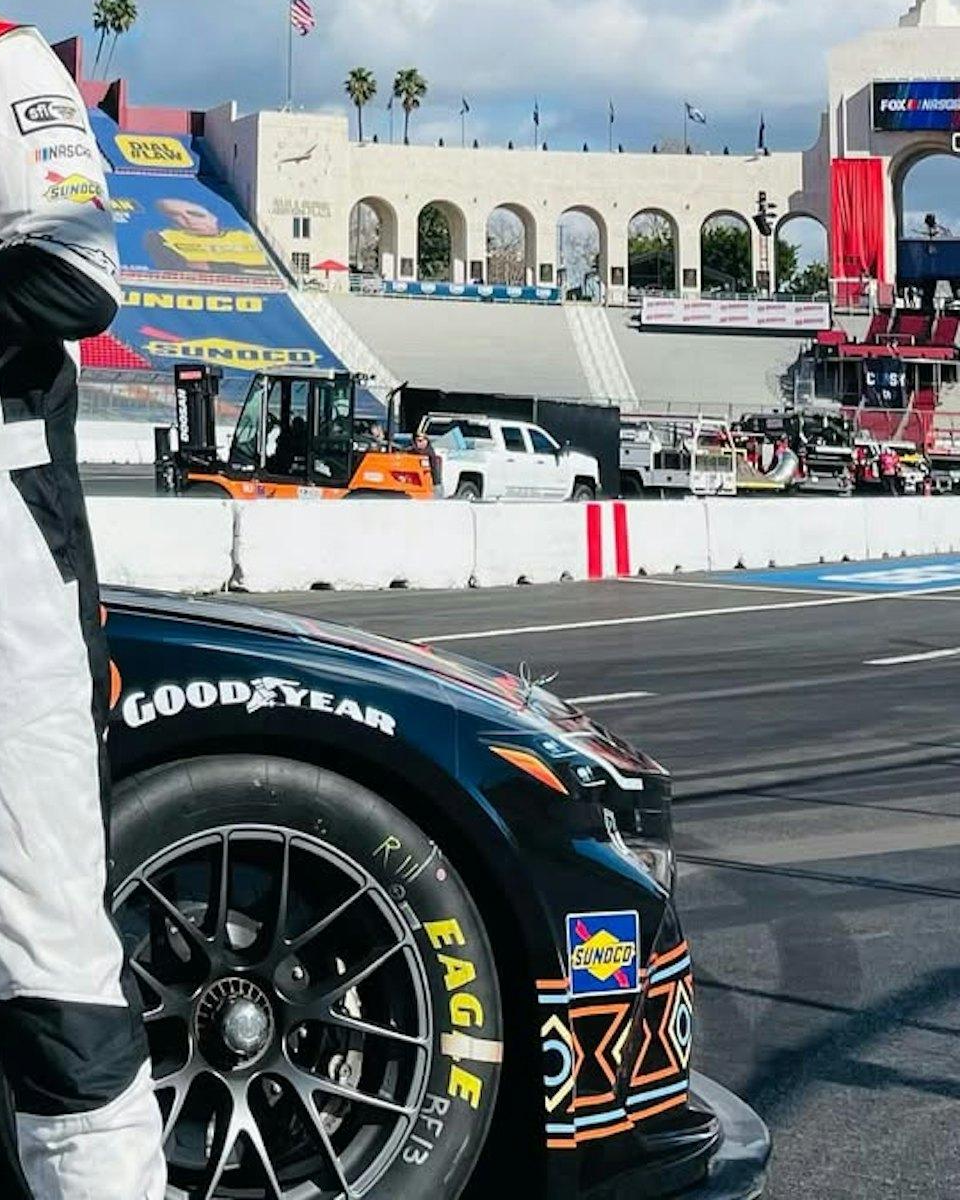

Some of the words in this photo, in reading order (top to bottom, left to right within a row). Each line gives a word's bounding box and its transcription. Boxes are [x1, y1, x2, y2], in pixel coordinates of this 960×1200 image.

[880, 98, 906, 112] FOX
[50, 184, 103, 199] SUNOCO
[121, 290, 263, 313] UNOCO
[154, 343, 315, 363] SUNOCO
[121, 676, 397, 736] GOODYEAR
[574, 945, 633, 967] SUNOCO
